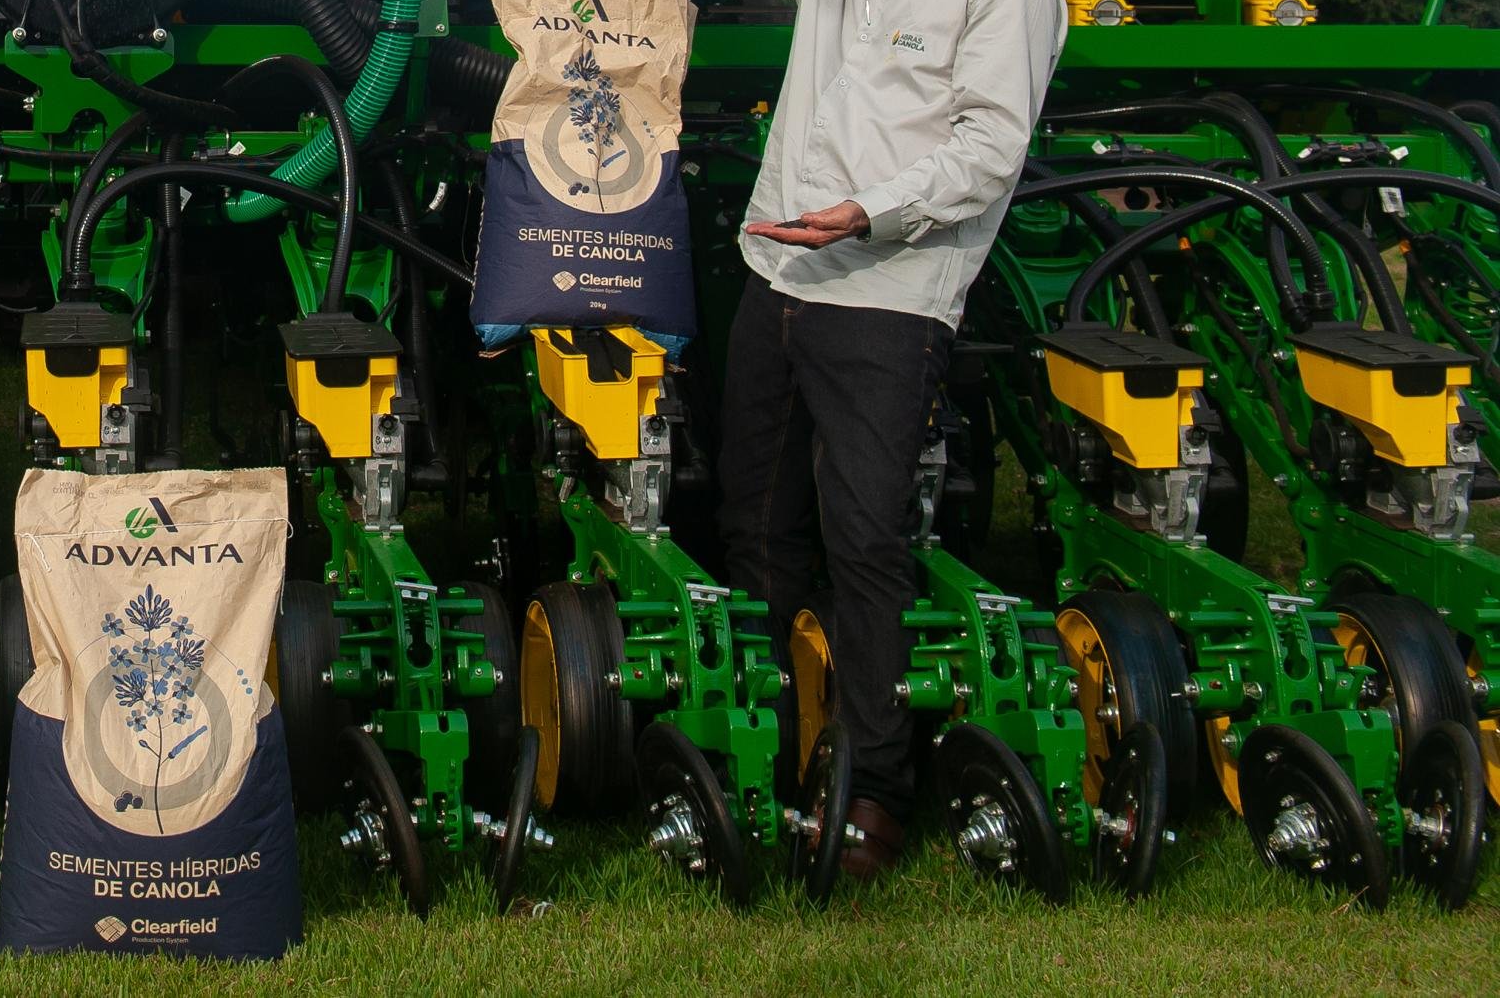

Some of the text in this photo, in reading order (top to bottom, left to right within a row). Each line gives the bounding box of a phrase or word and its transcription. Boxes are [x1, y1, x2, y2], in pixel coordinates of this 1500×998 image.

[532, 16, 657, 49] ADVANTA
[518, 228, 674, 251] SEMENTES HÍBRIDAS
[552, 245, 645, 262] DE CANOLA
[580, 273, 642, 288] Clearfield
[590, 301, 607, 310] 20kg
[64, 543, 244, 567] ADVANTA
[49, 851, 261, 879] SEMENTES HÍBRIDAS
[94, 879, 221, 899] DE CANOLA
[131, 917, 217, 934] Clearfield
